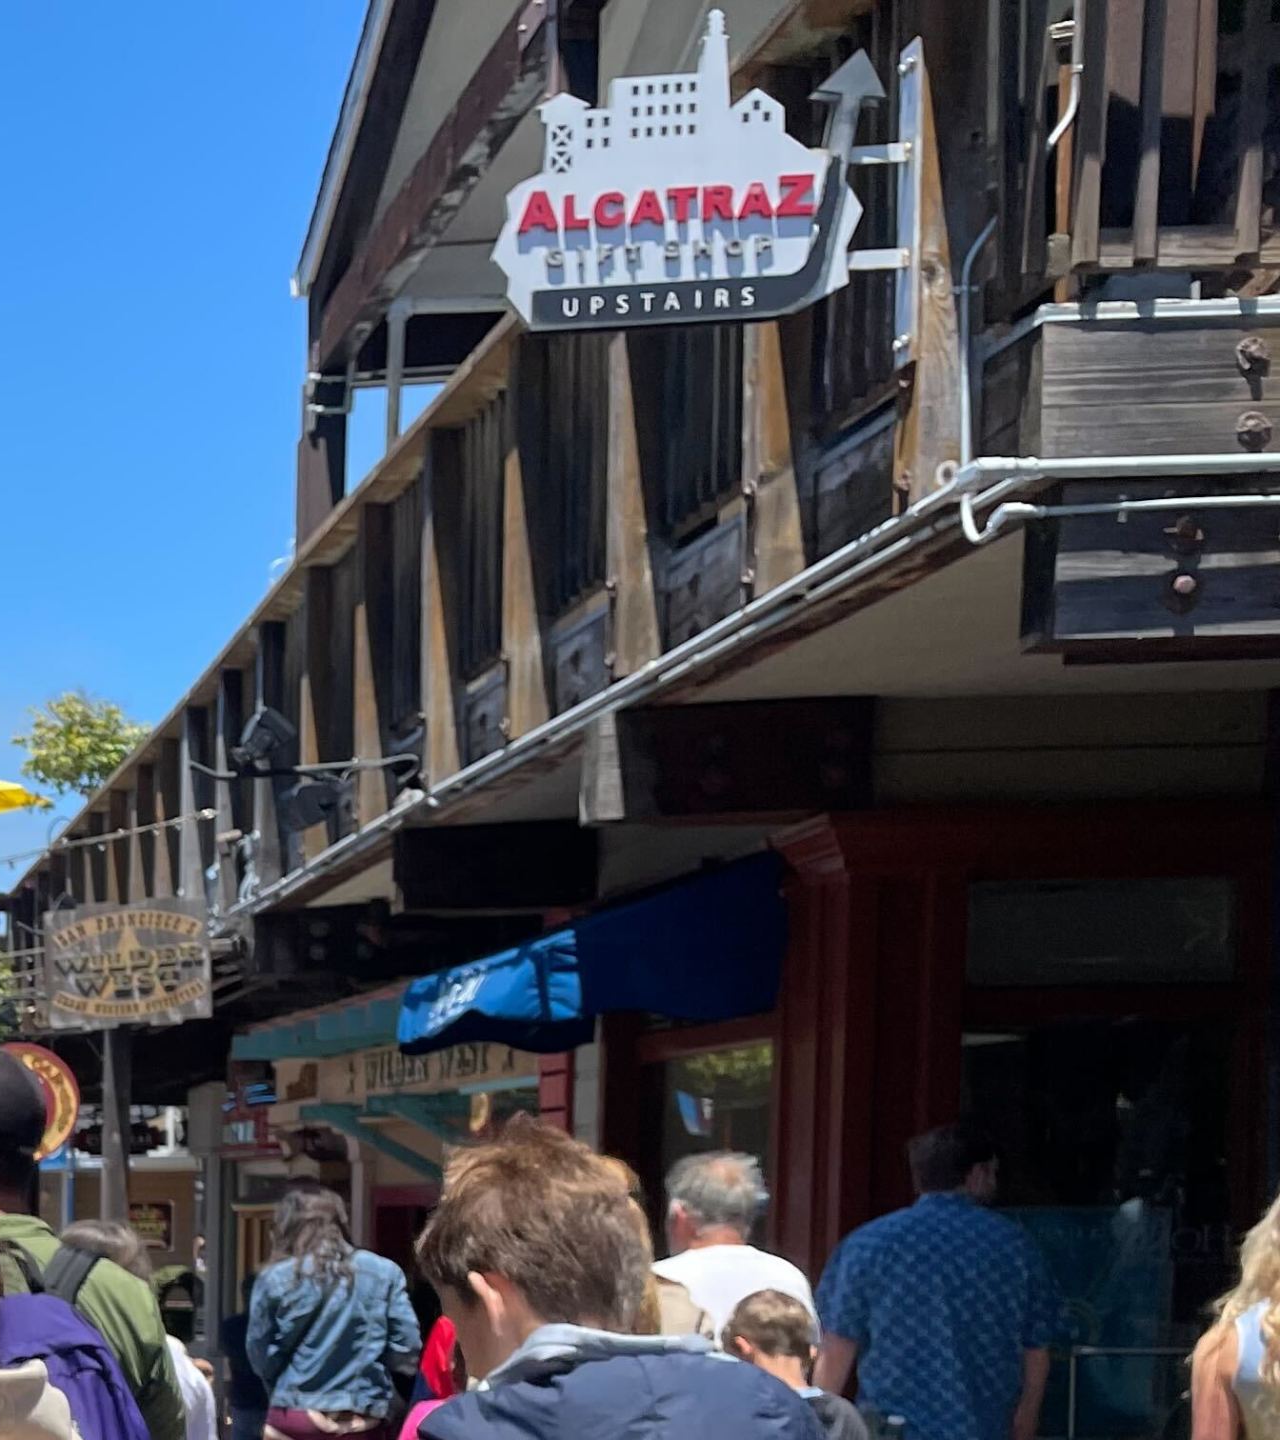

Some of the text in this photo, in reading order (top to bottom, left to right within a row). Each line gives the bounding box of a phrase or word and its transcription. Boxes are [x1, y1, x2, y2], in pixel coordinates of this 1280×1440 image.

[518, 174, 815, 234] ALCATRAZ
[546, 236, 772, 267] GIFT SHOP
[562, 286, 756, 317] UPSTAIRS
